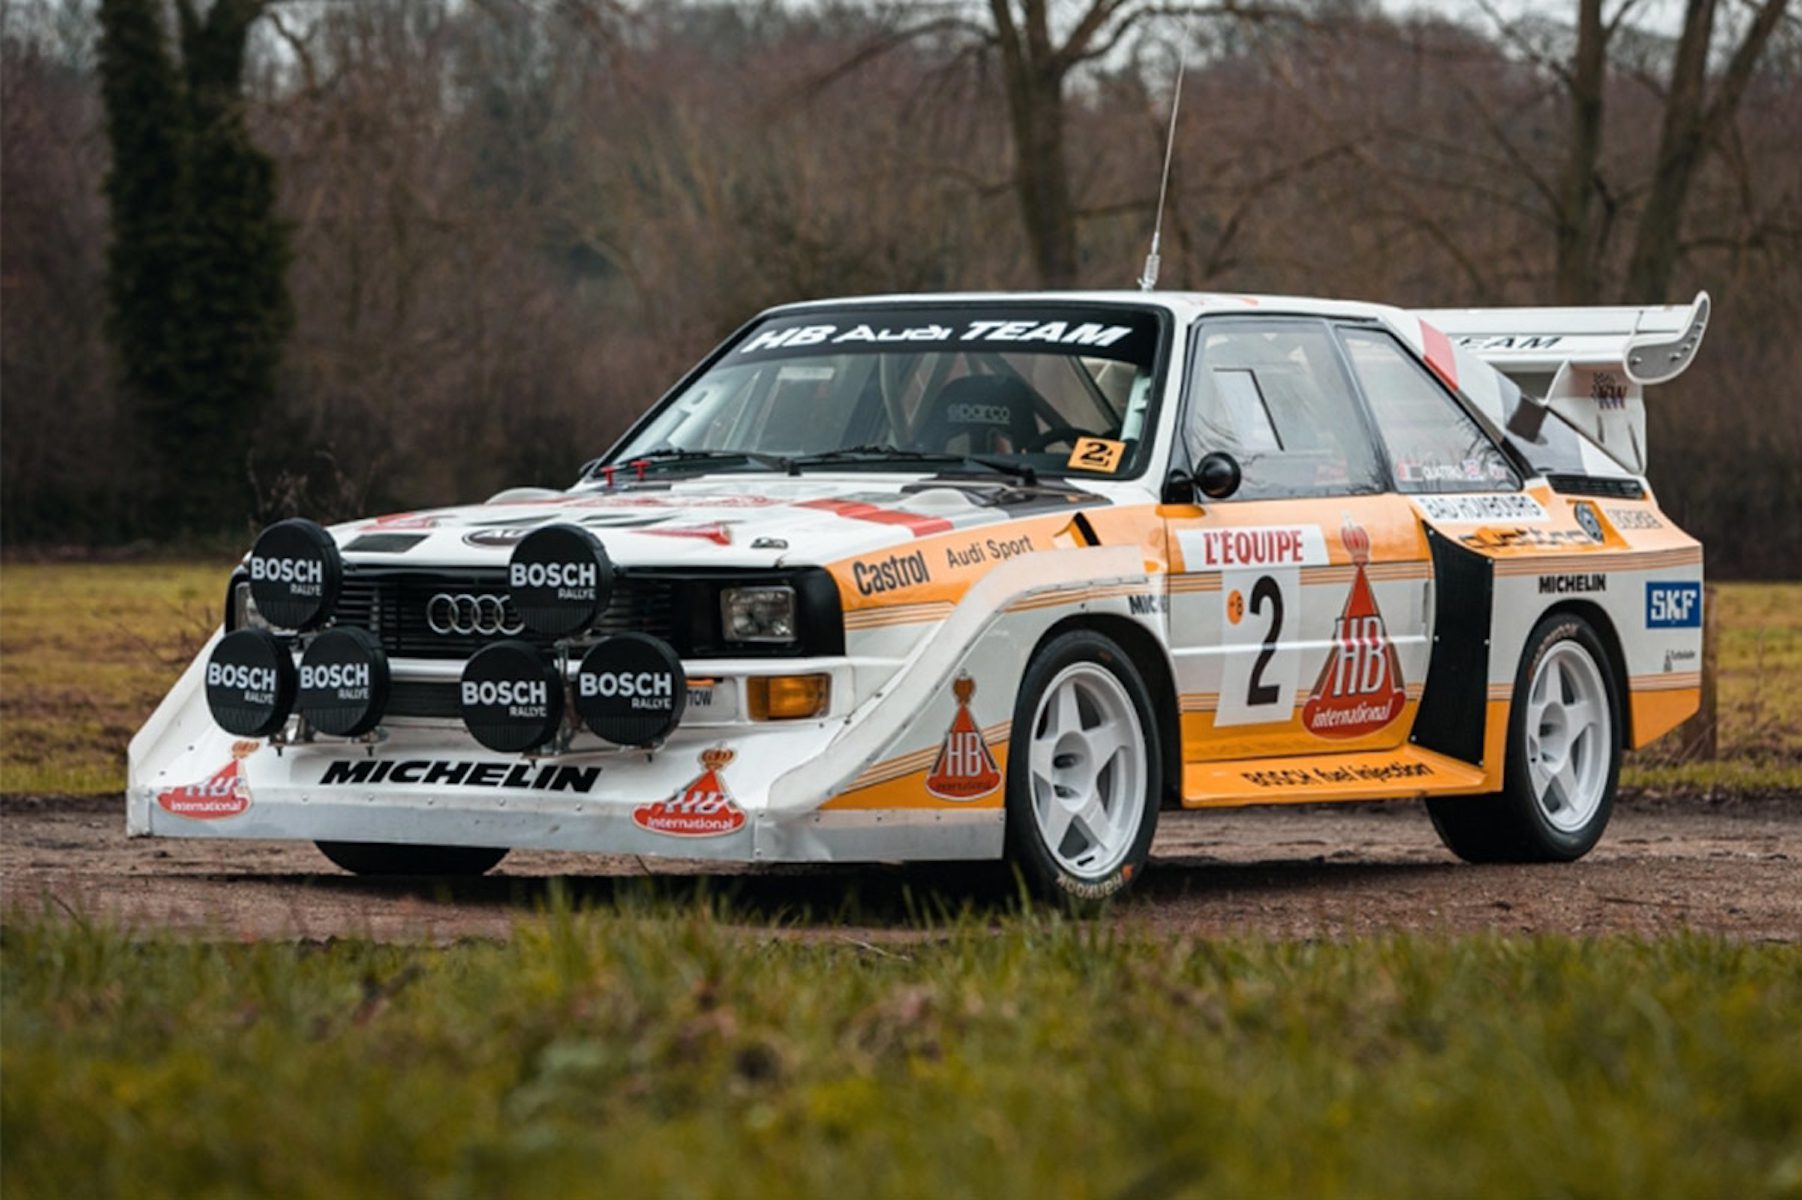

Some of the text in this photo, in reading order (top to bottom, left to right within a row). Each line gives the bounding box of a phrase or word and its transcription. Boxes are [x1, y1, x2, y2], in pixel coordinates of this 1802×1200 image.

[740, 320, 1133, 353] HB Audi TEAM
[1459, 335, 1563, 349] EAM
[251, 556, 322, 583] BOSCH
[509, 562, 596, 587] BOSCH
[852, 535, 1035, 596] Castrol Audi Sport
[290, 583, 322, 596] RALLYE
[557, 588, 596, 600] RALLYE
[1538, 573, 1607, 594] MICHELIN
[1650, 589, 1697, 621] SKF
[1247, 575, 1284, 706] 2
[1332, 615, 1387, 696] HB
[207, 662, 276, 691] BOSCH
[300, 663, 369, 689] BOSCH
[580, 672, 672, 697] BOSCH
[244, 690, 275, 704] RALLYE
[337, 688, 369, 700] RALLYE
[461, 681, 547, 706] BOSCH
[631, 697, 672, 710] RALLYE
[509, 705, 547, 718] RALLYE
[1310, 698, 1393, 728] international
[945, 732, 981, 776] HB
[319, 760, 603, 793] MICHELIN
[646, 815, 735, 831] international
